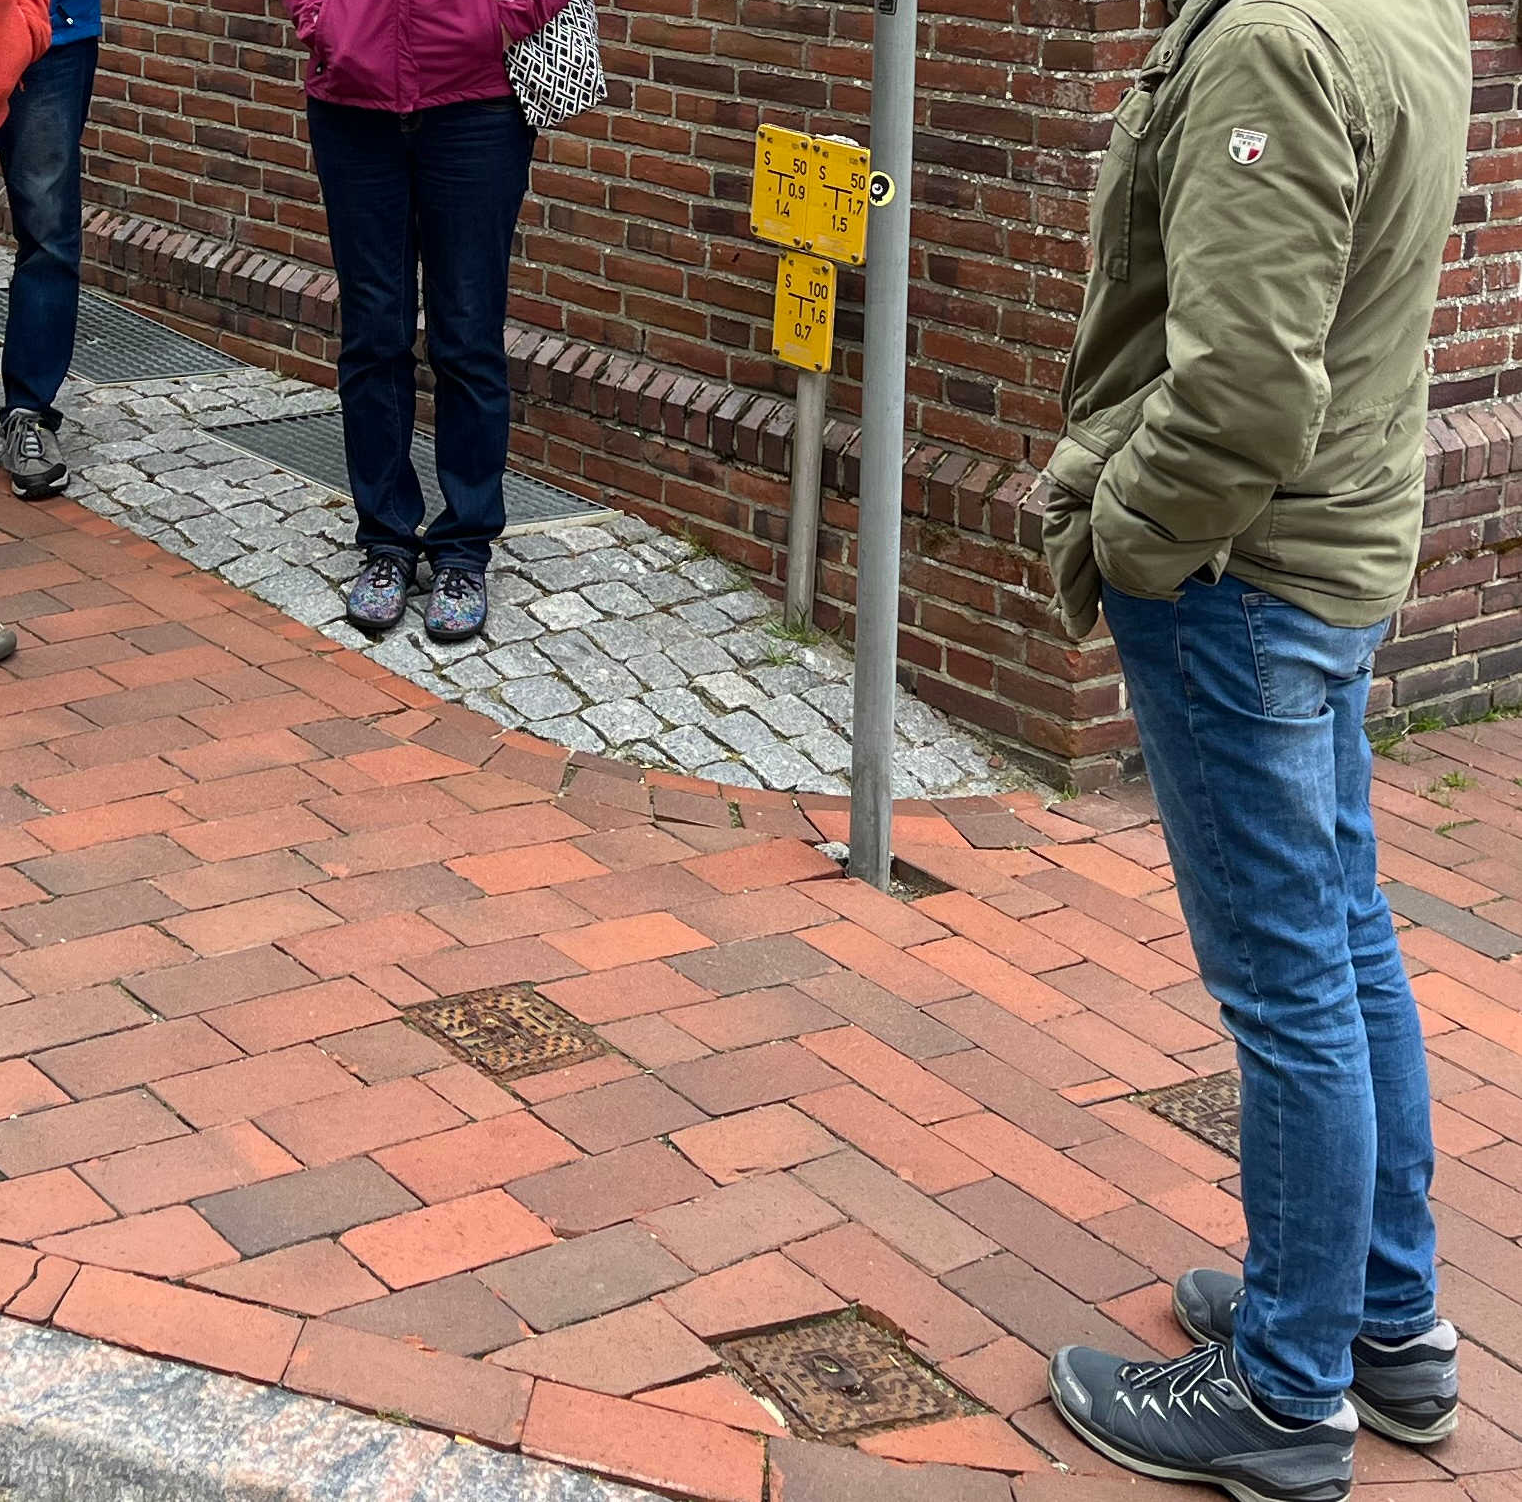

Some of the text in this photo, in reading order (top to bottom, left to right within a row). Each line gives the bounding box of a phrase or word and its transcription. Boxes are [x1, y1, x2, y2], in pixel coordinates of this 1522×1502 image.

[764, 150, 807, 175] S 50
[819, 165, 866, 190] S 50
[785, 273, 828, 300] S 100
